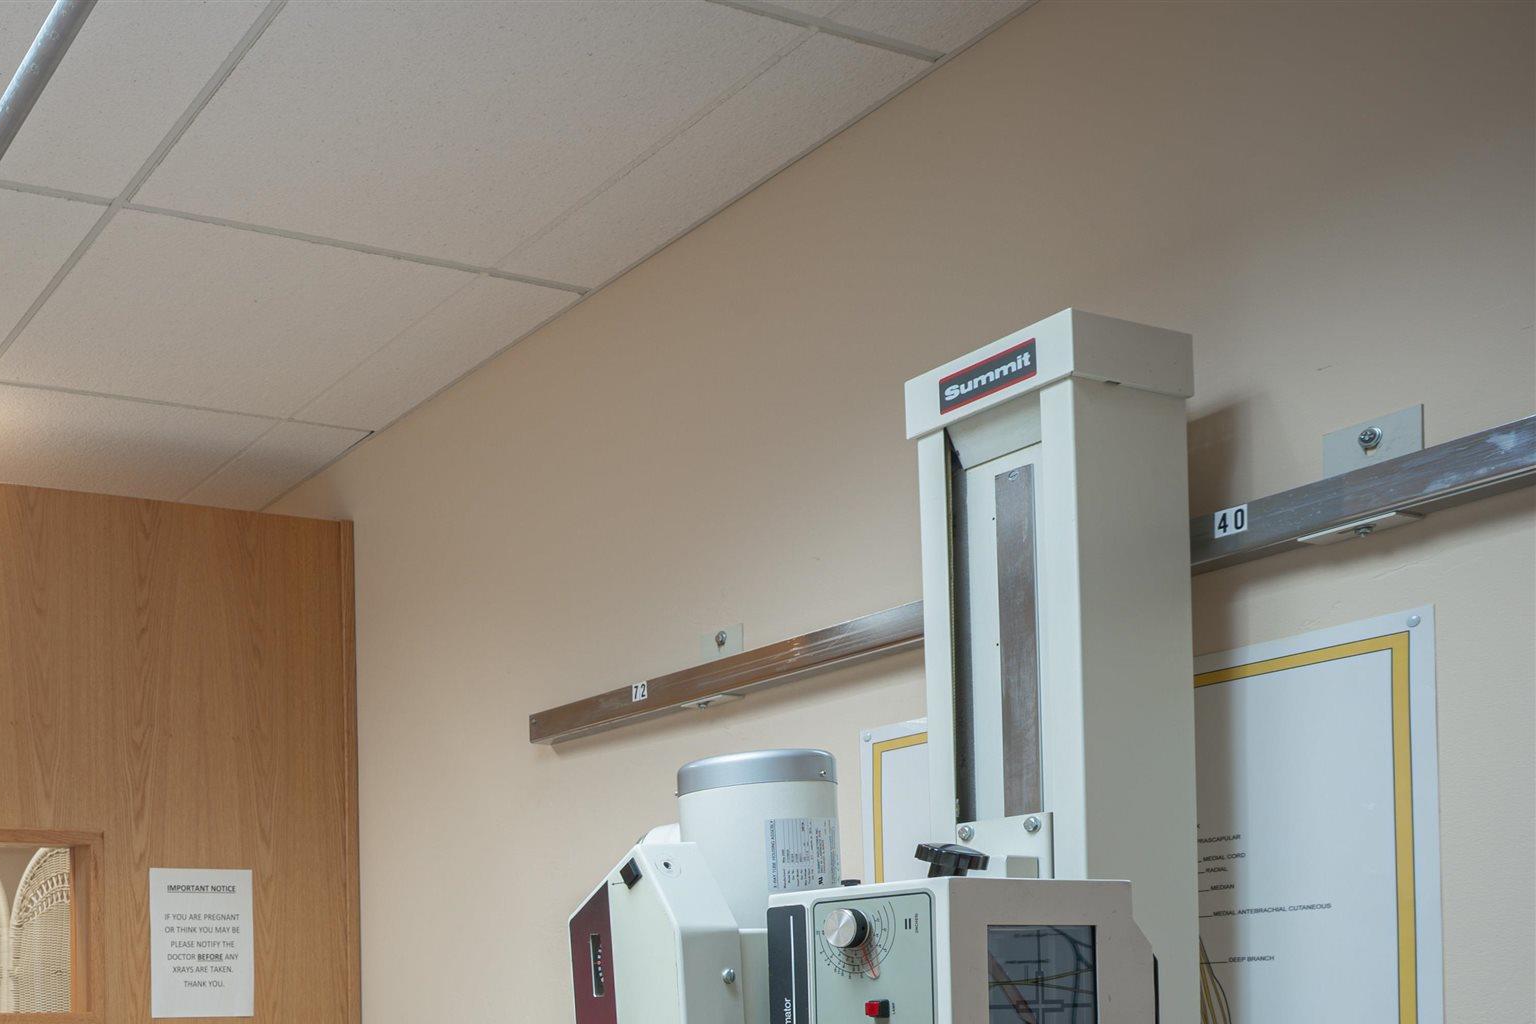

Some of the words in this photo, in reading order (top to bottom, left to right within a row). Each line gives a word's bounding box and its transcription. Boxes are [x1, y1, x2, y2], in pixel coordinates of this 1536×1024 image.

[944, 351, 1031, 401] Summit
[1217, 508, 1245, 534] 40
[634, 684, 646, 699] 72
[211, 885, 236, 893] NOTICE
[1238, 906, 1287, 915] ANTEBRACHIAL
[1288, 903, 1332, 911] CUTANEOUS
[197, 954, 223, 962] BEFORE
